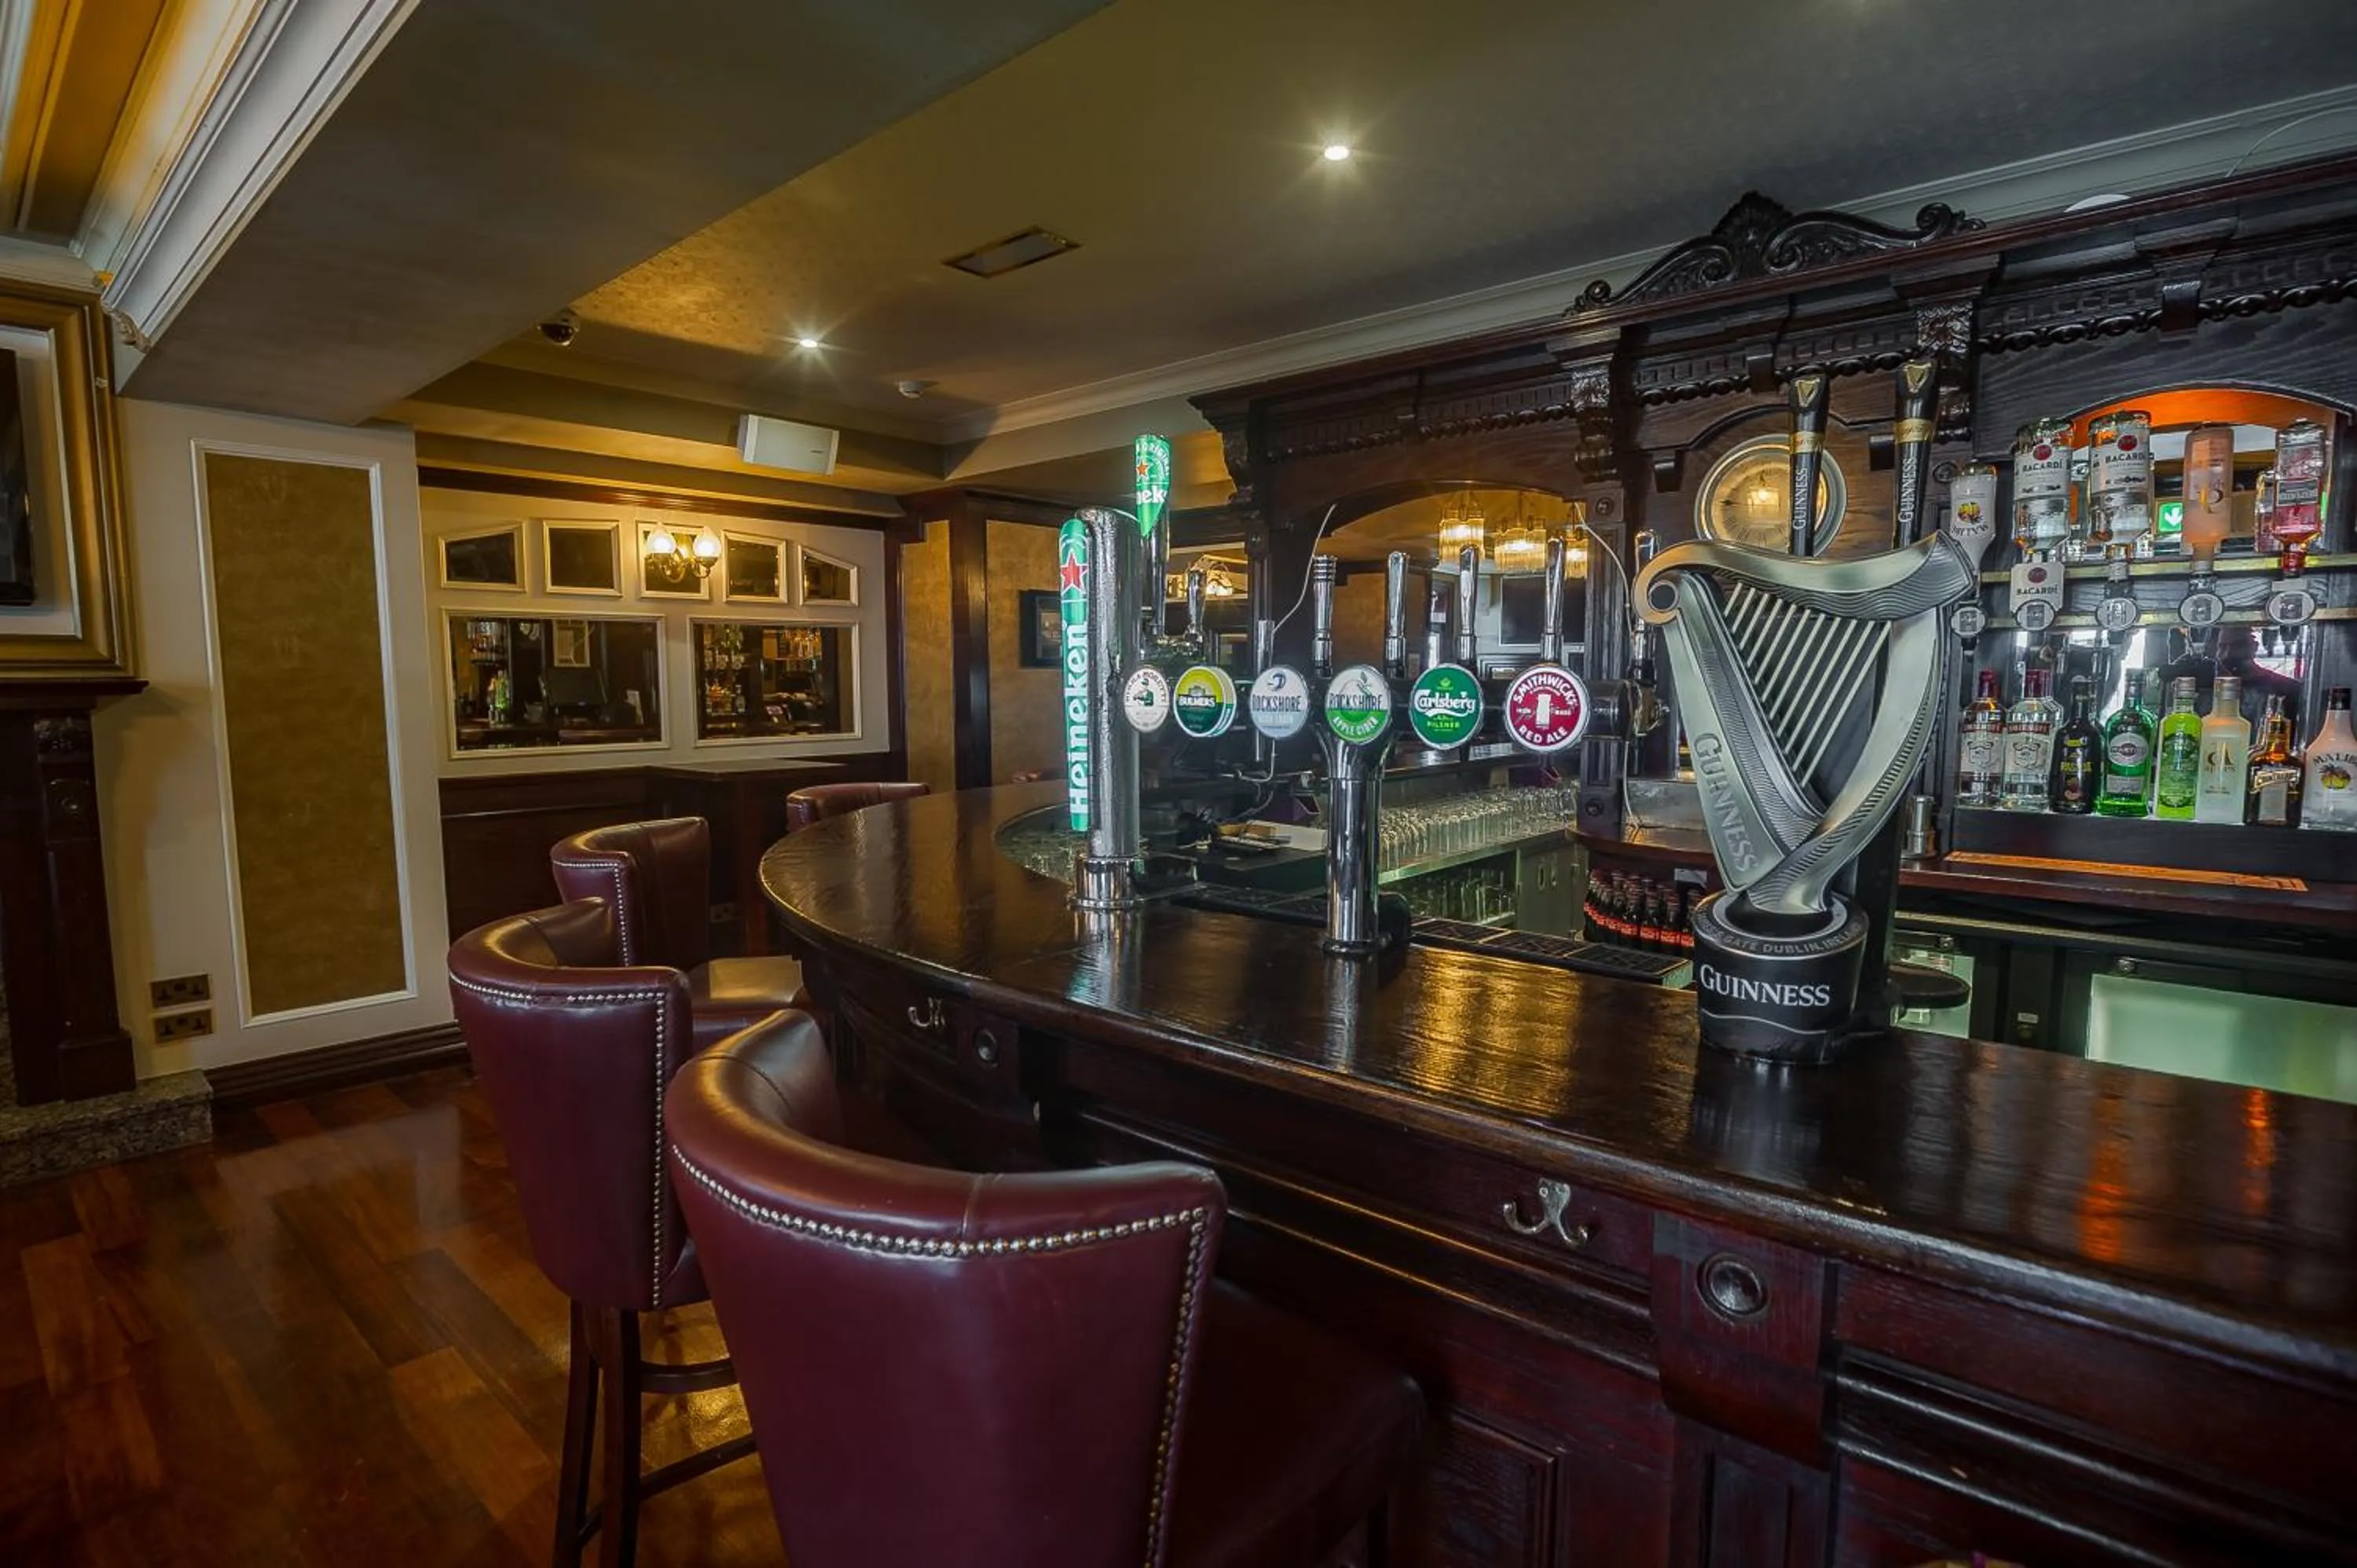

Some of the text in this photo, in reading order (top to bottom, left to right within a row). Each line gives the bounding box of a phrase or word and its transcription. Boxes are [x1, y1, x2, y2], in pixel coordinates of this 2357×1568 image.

[1792, 467, 1808, 530] GUINNESS
[1898, 457, 1917, 522] GUINNESS
[1065, 621, 1088, 814] Heineken
[1414, 689, 1476, 714] Carlsberg
[1519, 725, 1567, 744] RED ALE
[1694, 732, 1758, 872] GUINNESS
[1699, 963, 1831, 1007] GUINNESS
